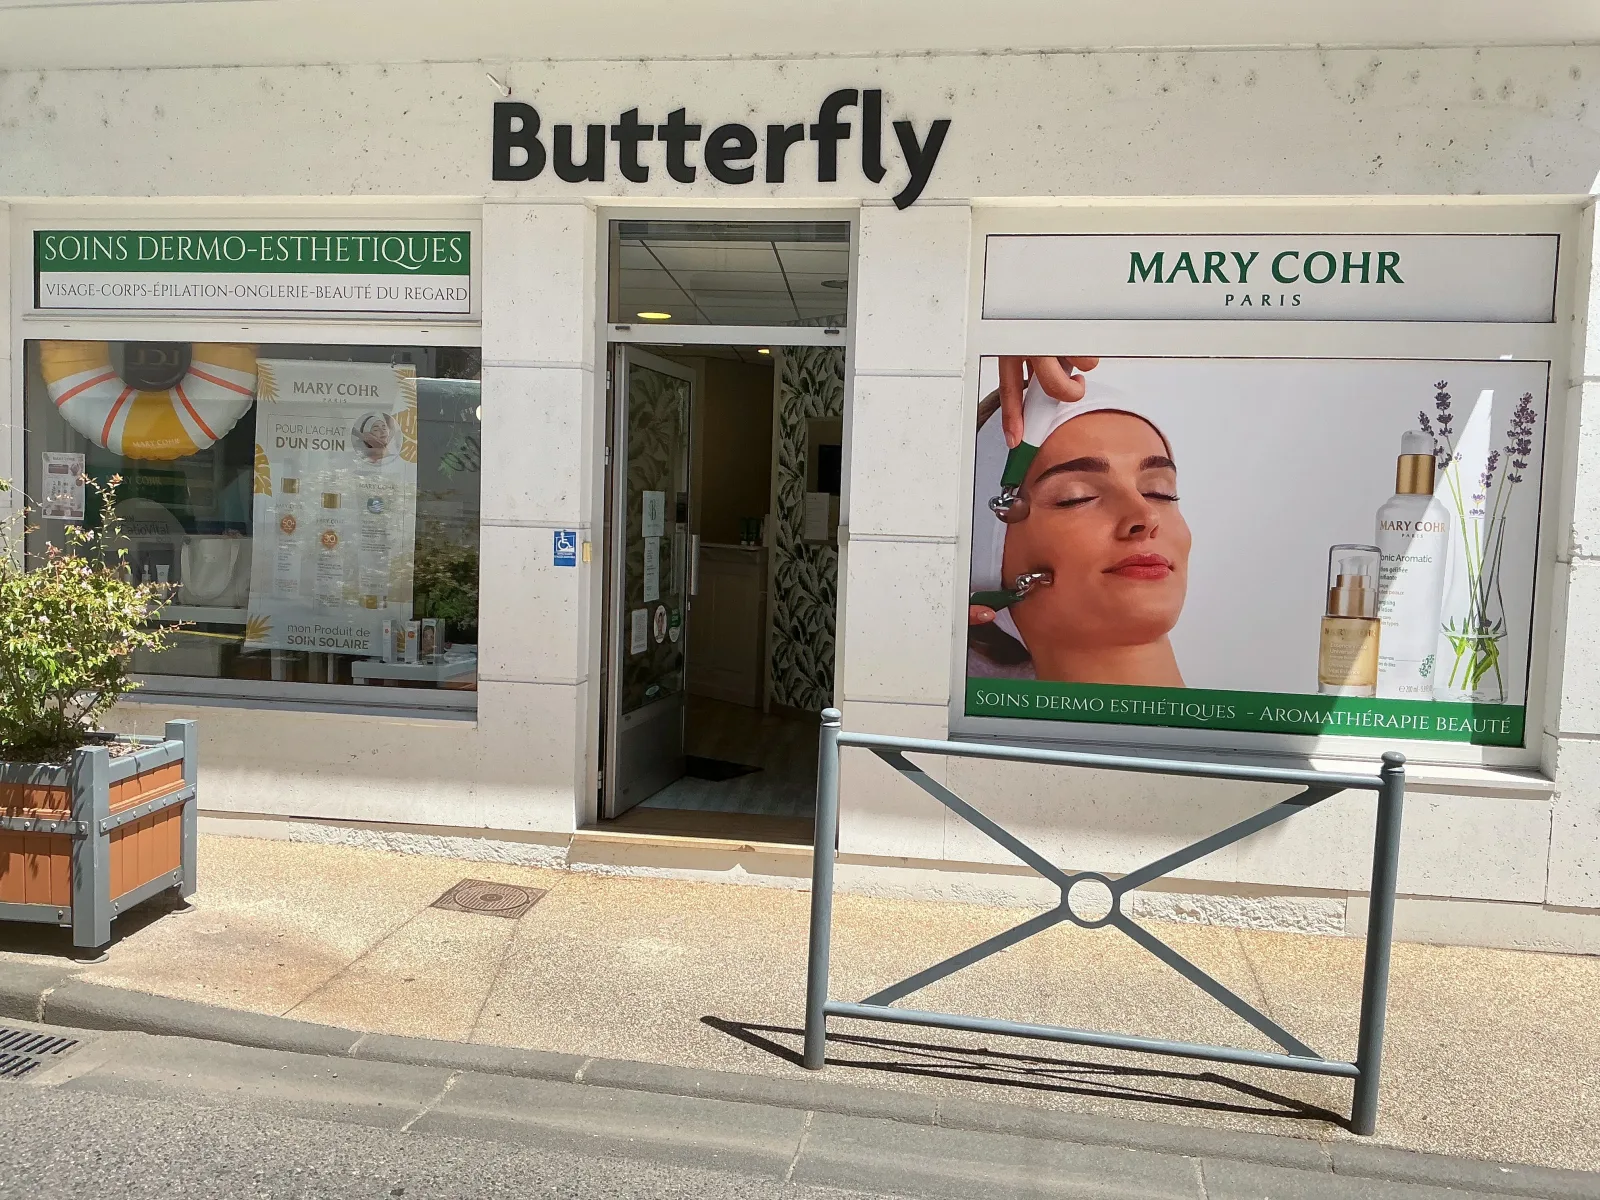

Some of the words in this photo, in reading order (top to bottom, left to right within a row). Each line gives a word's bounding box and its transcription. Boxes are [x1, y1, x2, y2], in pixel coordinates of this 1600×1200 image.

[492, 89, 952, 210] Butterfly
[44, 235, 128, 261] SOINS
[137, 236, 463, 270] DERMO-ESTHETIQUES
[1127, 251, 1259, 284] MARY
[1271, 251, 1405, 284] COHR
[377, 286, 400, 300] DU
[404, 287, 468, 301] REGARD
[1225, 294, 1301, 307] PARIS
[293, 381, 333, 395] MARY
[337, 383, 379, 398] COHR
[275, 424, 304, 434] POUR
[305, 425, 346, 436] L'ACHAT
[276, 437, 308, 450] D'UN
[311, 438, 345, 452] SOIN
[1380, 520, 1411, 531] MARY
[1415, 521, 1445, 533] COHR
[1379, 553, 1395, 562] onic
[1395, 553, 1433, 563] Aromatic
[287, 624, 311, 633] mon
[314, 625, 353, 637] Produit
[355, 627, 371, 637] de
[287, 635, 316, 646] SOIN
[318, 637, 369, 650] SOLAIRE
[976, 690, 1029, 709] SOINS
[1035, 695, 1104, 712] DERMO
[1110, 698, 1236, 722] ESTHÉTIQUES
[1436, 716, 1511, 735] BEAUTÉ
